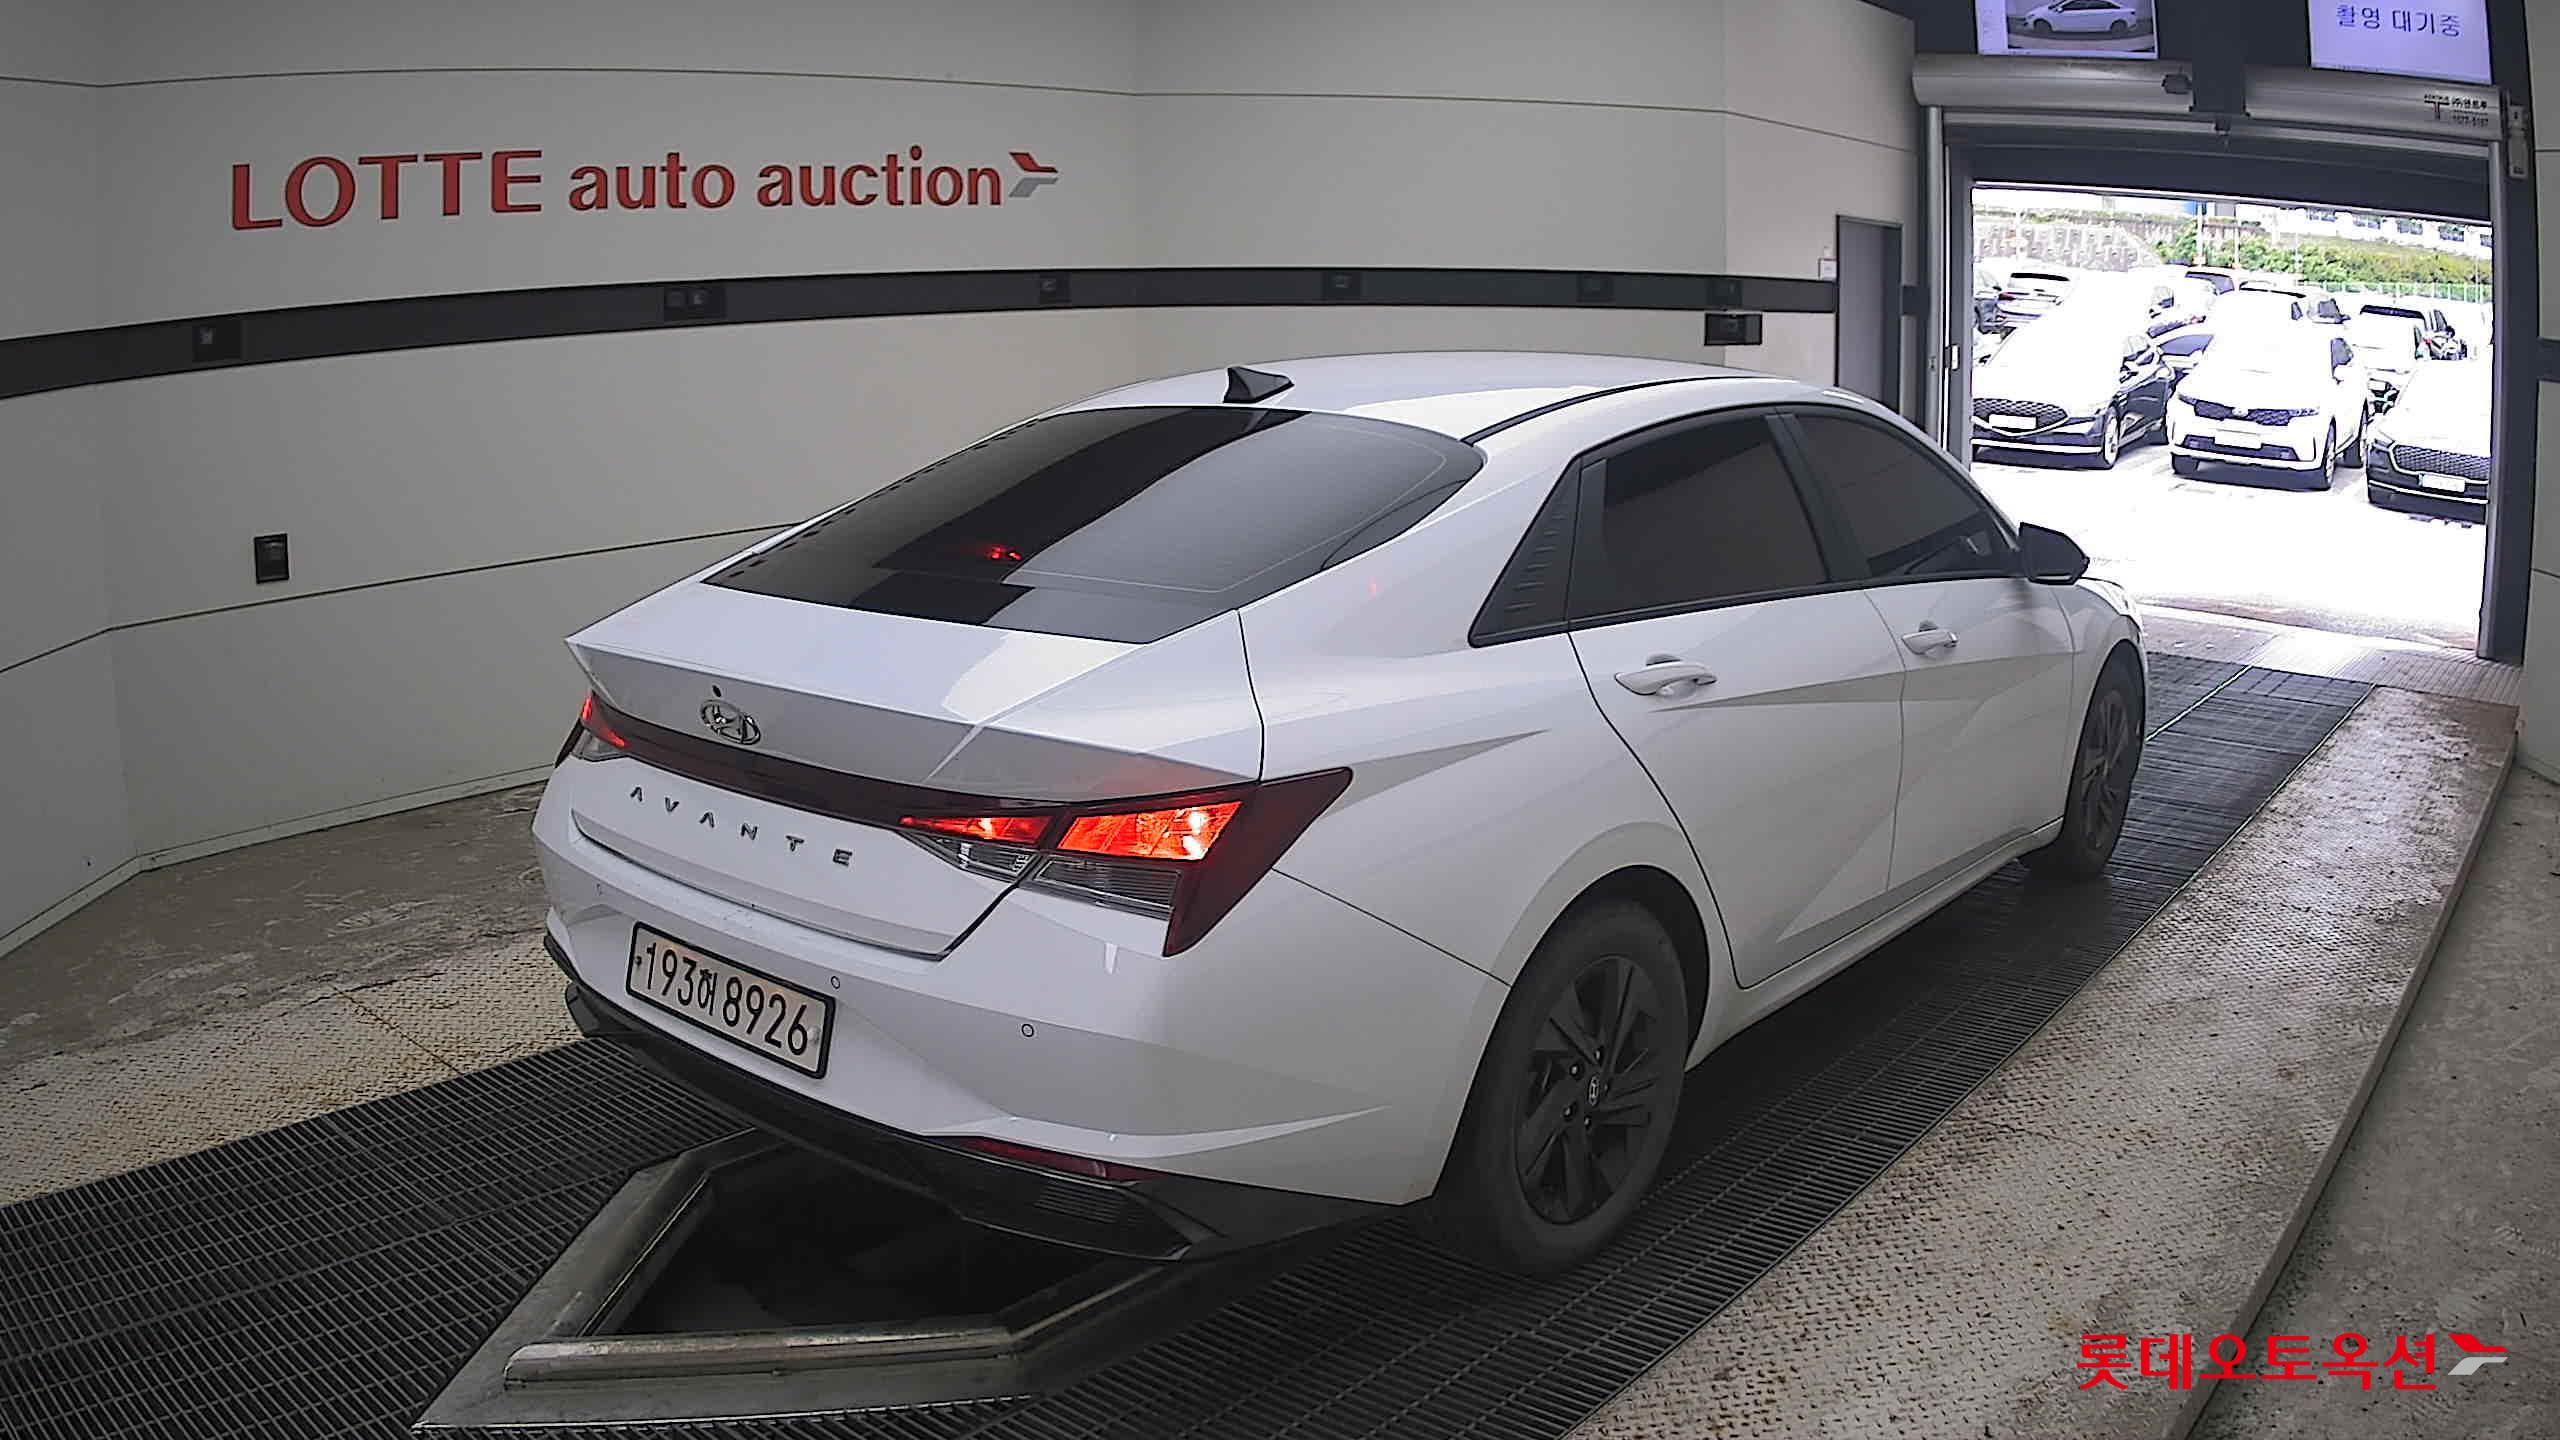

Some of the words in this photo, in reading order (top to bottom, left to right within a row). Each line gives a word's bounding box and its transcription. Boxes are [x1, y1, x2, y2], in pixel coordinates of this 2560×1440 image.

[2336, 4, 2381, 30] 촬영
[2392, 10, 2462, 38] 대기중
[232, 149, 543, 230] LOTTE
[568, 151, 736, 211] auto
[756, 145, 1002, 208] auction
[629, 786, 854, 867] AVANTE
